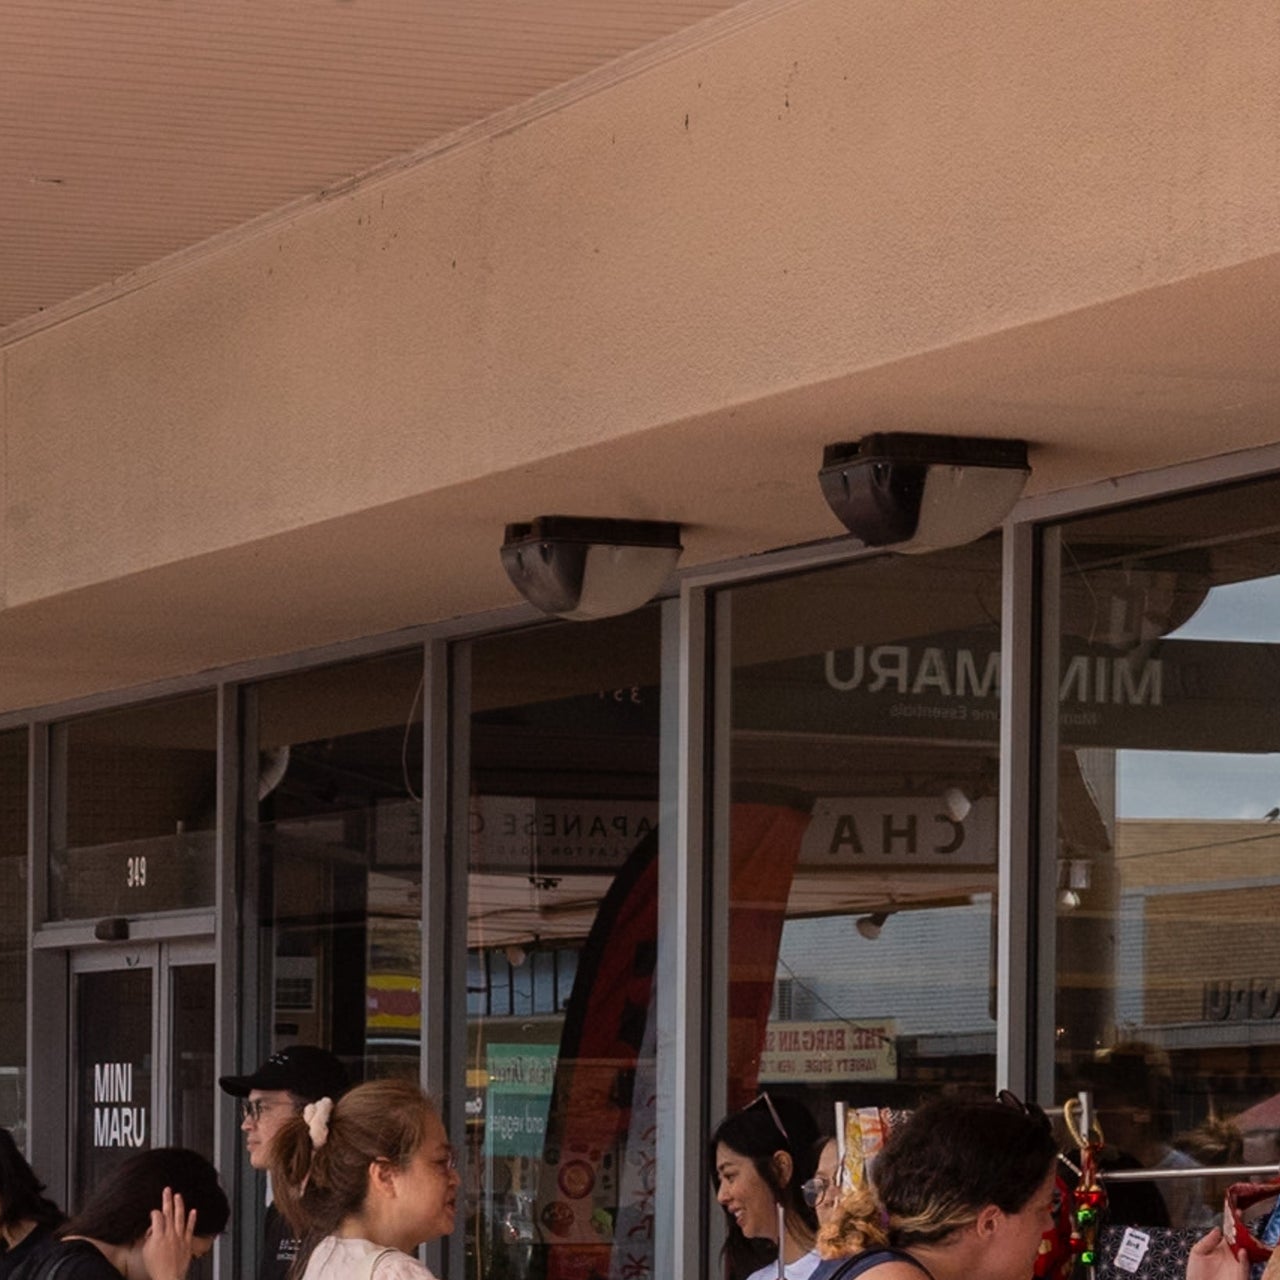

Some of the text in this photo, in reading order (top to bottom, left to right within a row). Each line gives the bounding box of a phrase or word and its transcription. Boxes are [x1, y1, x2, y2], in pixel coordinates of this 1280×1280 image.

[127, 856, 146, 888] 349
[94, 1062, 132, 1103] MINI
[94, 1107, 146, 1148] MARU
